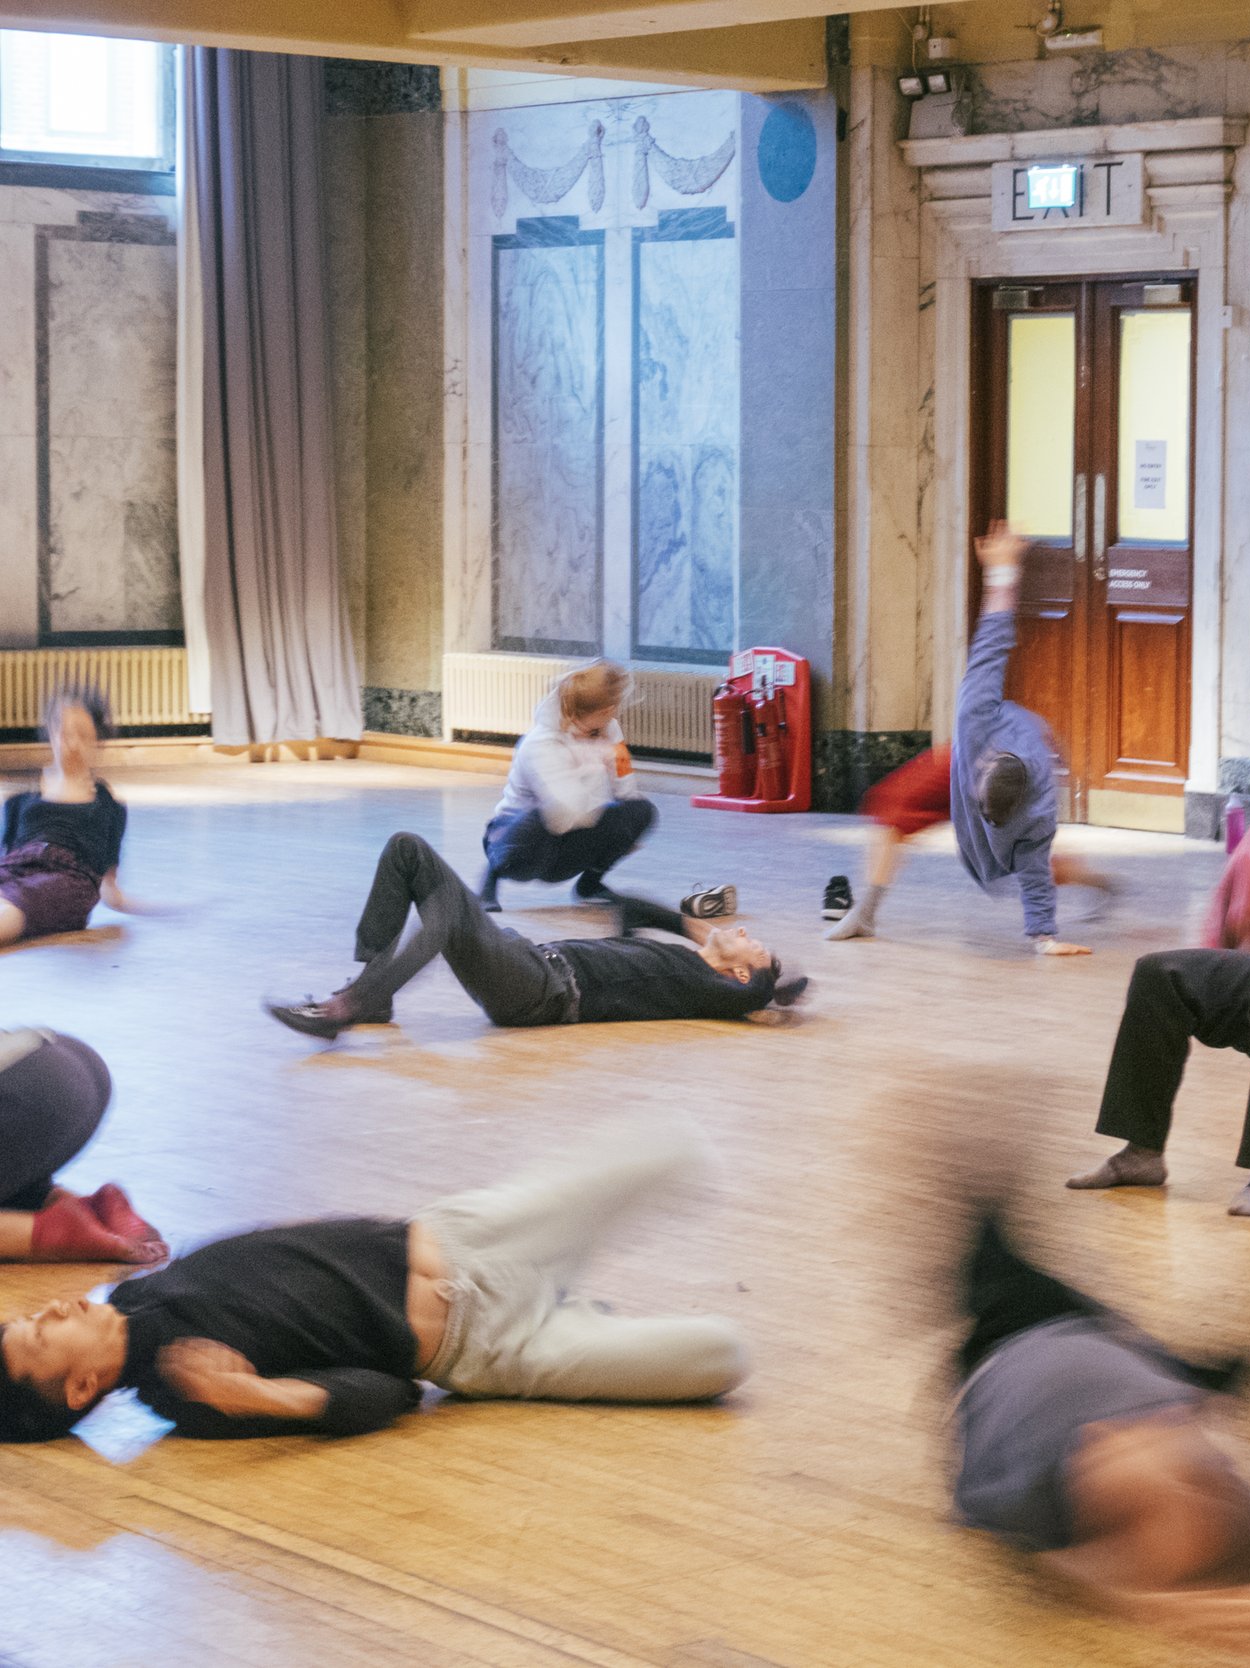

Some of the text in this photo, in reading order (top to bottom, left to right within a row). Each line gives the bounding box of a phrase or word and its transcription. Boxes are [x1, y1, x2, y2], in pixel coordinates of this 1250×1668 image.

[1012, 161, 1123, 220] EIT
[1109, 568, 1148, 578] EMERGENCY
[1108, 579, 1151, 589] ACCESS ONLY
